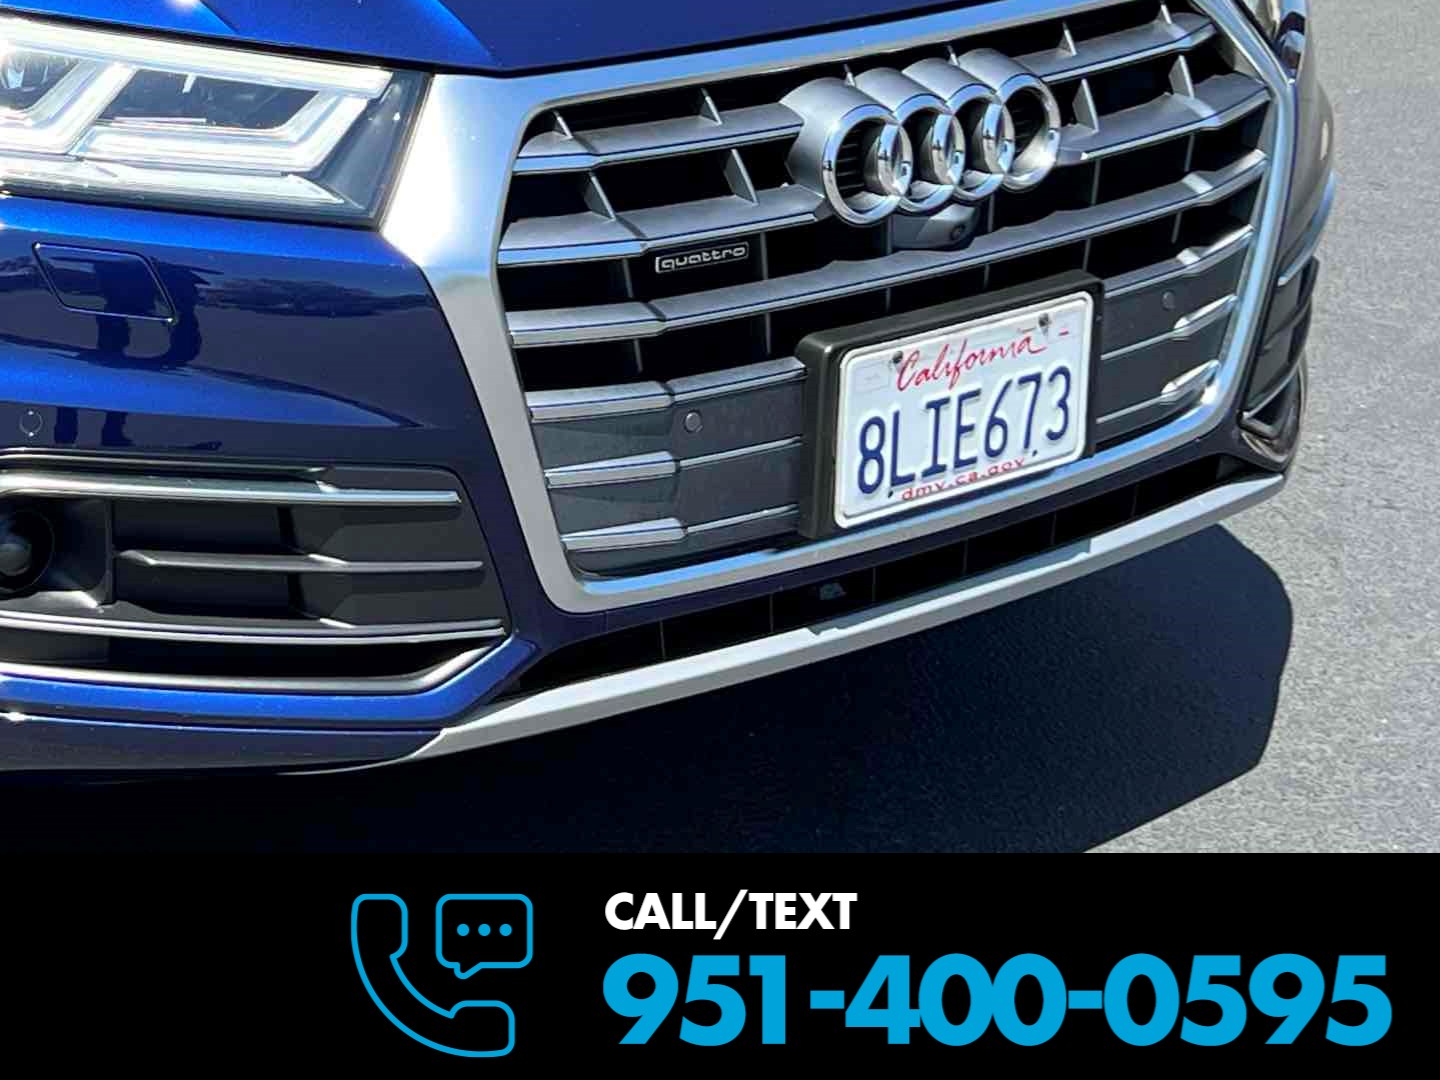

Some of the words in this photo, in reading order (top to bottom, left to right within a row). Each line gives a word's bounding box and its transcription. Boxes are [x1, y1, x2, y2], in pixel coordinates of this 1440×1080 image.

[660, 245, 747, 272] quattro
[896, 338, 1047, 392] California
[857, 365, 1072, 495] 8LIE673
[901, 456, 1026, 502] dmv.ca.gov
